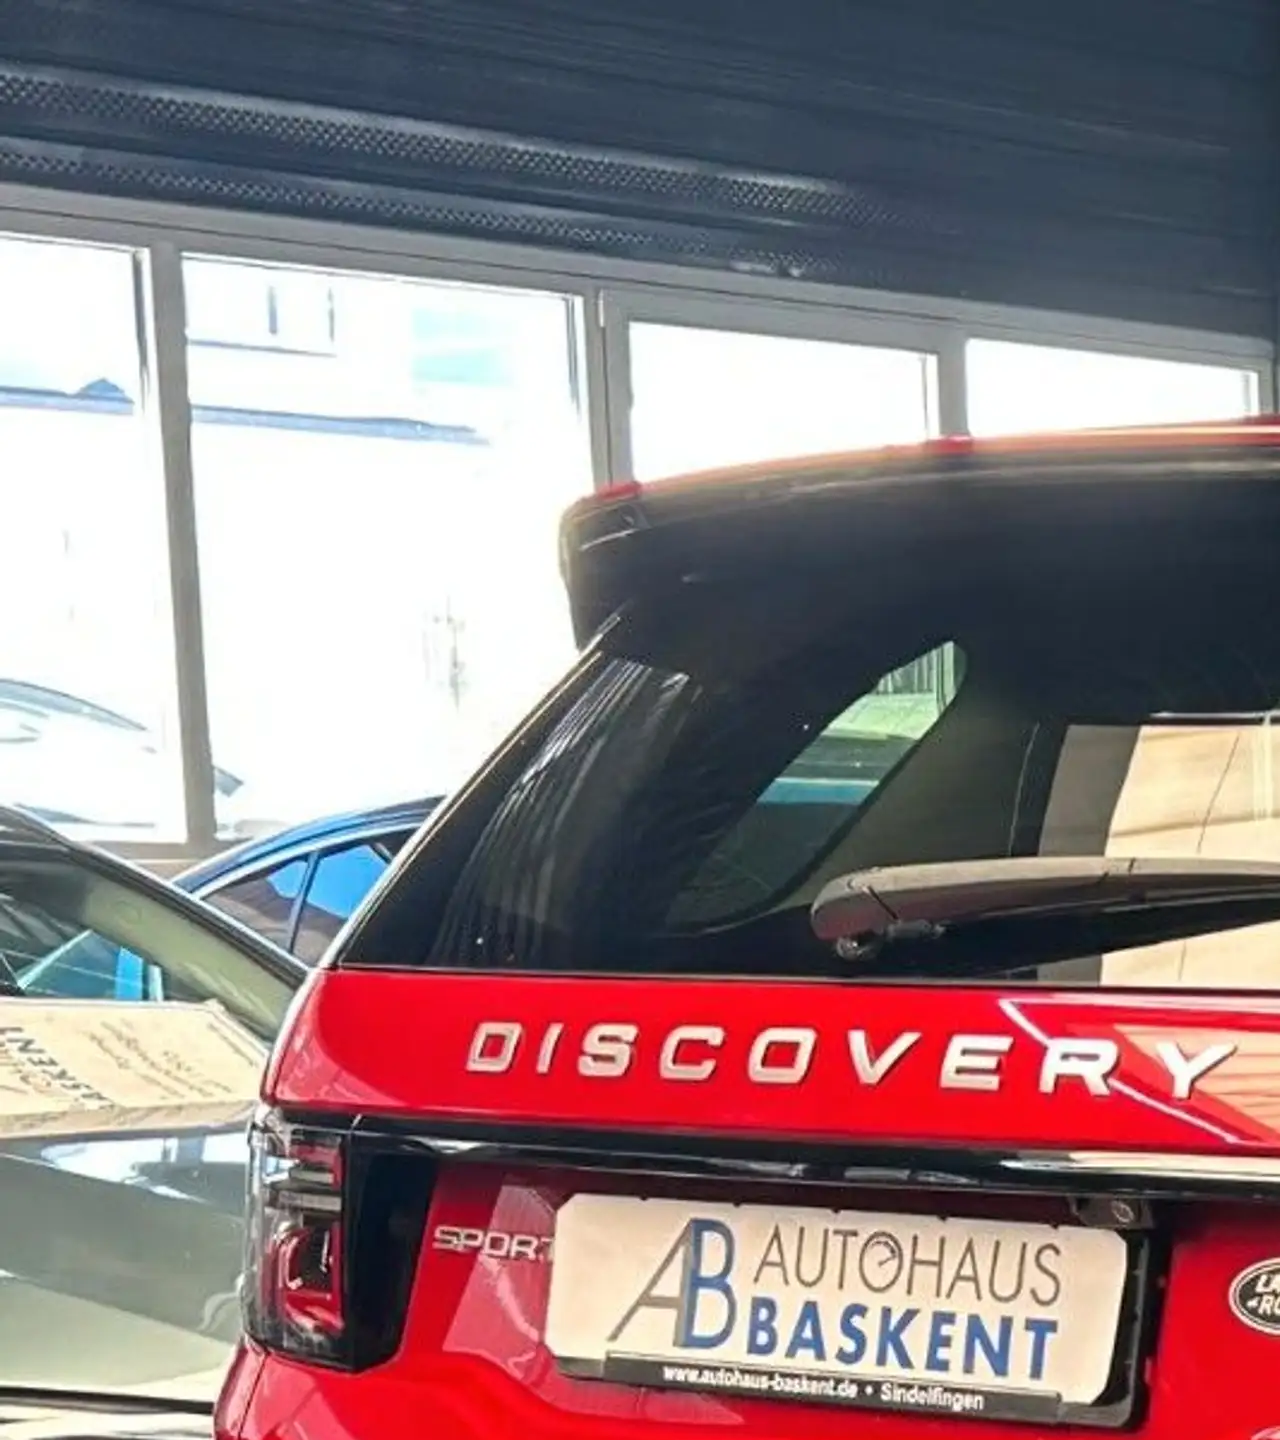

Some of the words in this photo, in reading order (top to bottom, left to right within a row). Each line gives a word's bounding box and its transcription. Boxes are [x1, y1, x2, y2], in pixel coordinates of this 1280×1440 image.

[465, 1021, 1238, 1099] DISCOVERY
[606, 1217, 738, 1350] AB
[752, 1223, 1064, 1307] AUTOHAUS
[746, 1296, 1060, 1381] BASKENT
[662, 1363, 859, 1399] www.autohaus-baskent.de
[880, 1381, 986, 1413] Sindelfingen
